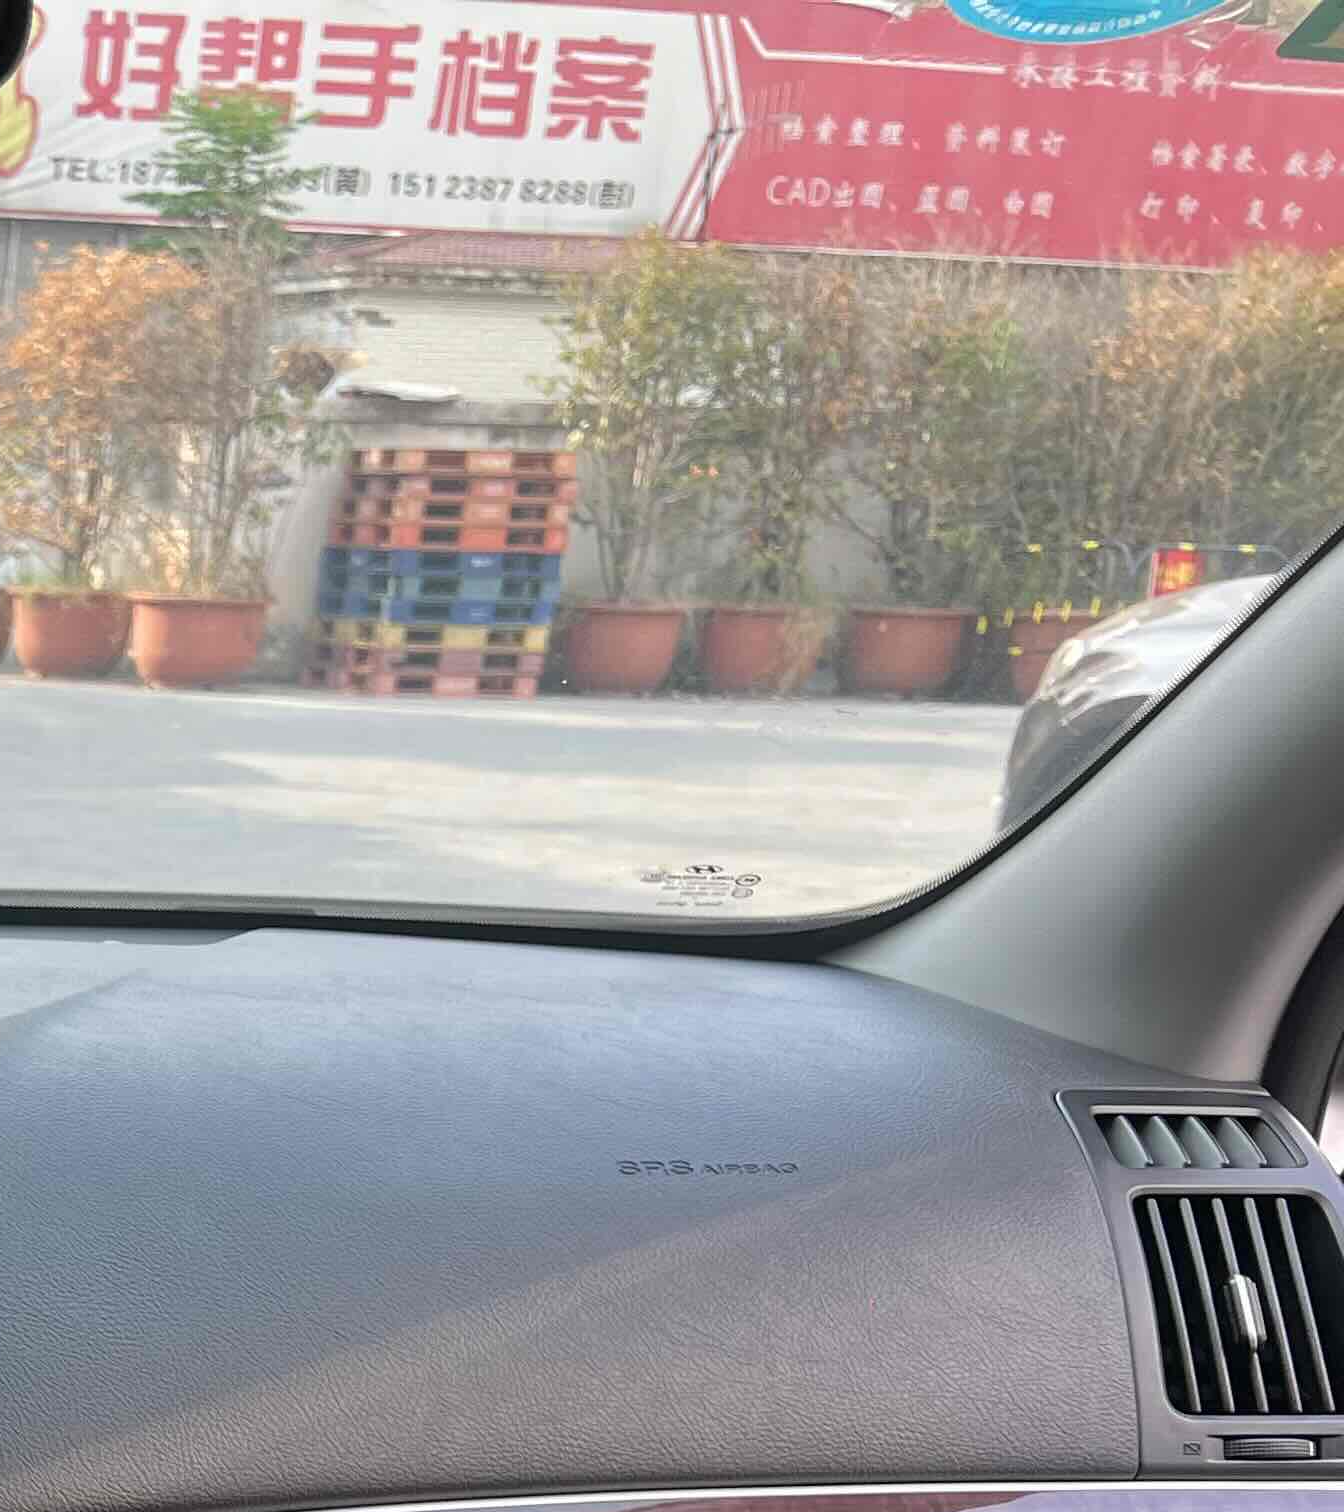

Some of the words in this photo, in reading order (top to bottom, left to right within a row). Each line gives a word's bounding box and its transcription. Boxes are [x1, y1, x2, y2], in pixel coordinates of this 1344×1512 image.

[72, 10, 657, 143] 好帮手档案
[615, 1159, 694, 1176] SRS
